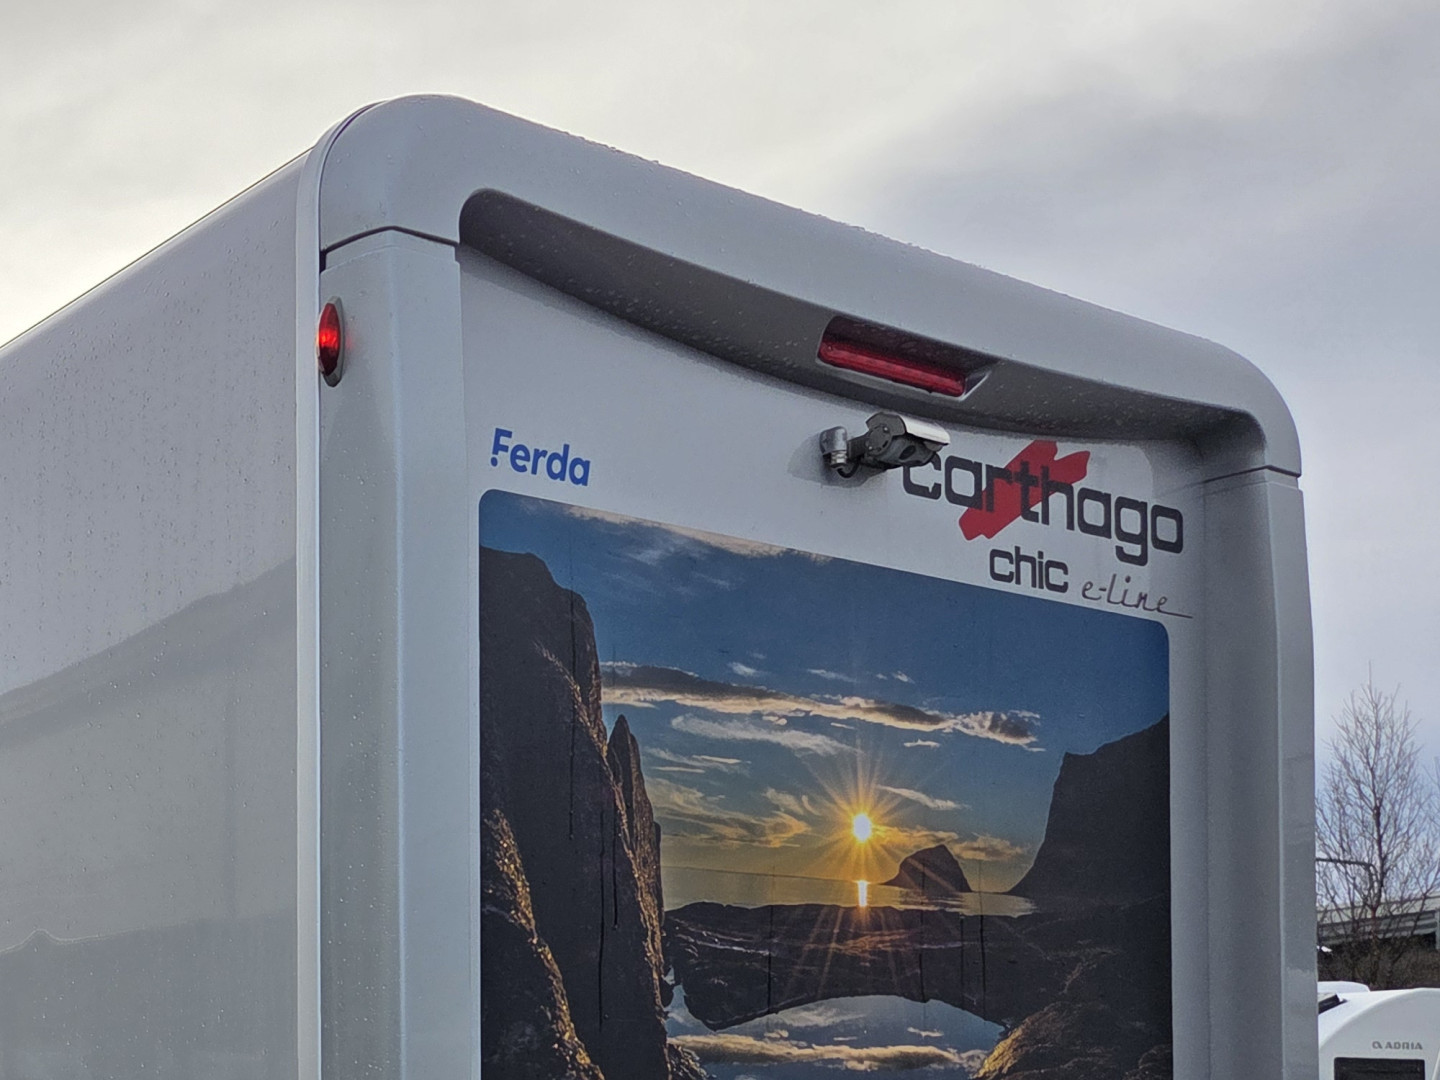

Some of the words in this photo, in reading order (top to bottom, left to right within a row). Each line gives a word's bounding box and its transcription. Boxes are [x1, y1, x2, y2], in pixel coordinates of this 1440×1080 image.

[490, 427, 591, 487] Ferda
[903, 452, 1184, 567] carthago
[989, 546, 1069, 593] chic
[1081, 573, 1193, 619] e-line
[1385, 1041, 1423, 1050] ADRIA
